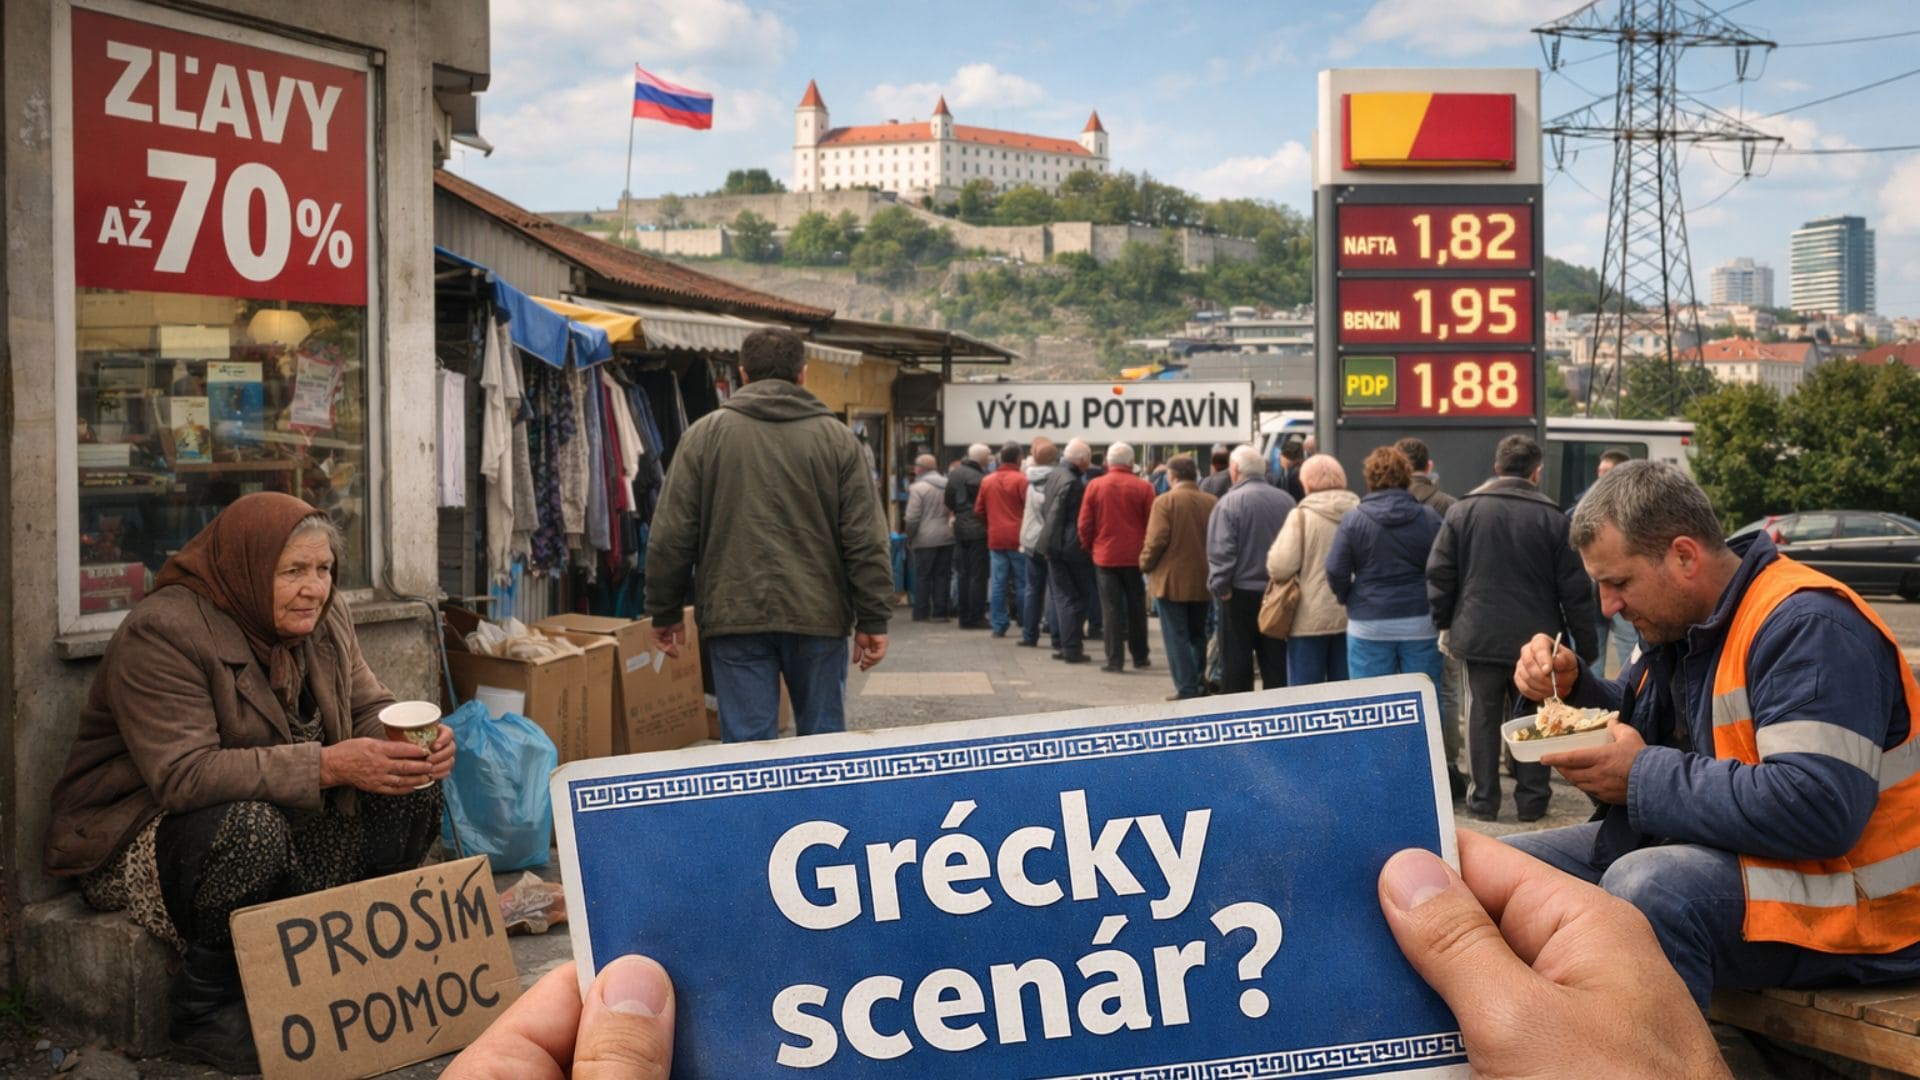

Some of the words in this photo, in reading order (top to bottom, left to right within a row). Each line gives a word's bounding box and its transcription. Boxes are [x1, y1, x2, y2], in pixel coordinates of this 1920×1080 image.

[105, 40, 343, 152] ZĽAVY
[97, 200, 152, 249] AŽ
[147, 148, 354, 282] 70%
[1343, 235, 1398, 256] NAFTA
[1412, 213, 1516, 266] 1,82
[1343, 310, 1401, 331] BENZIN
[1413, 287, 1517, 340] 1,95
[977, 393, 1071, 429] VÝDAJ
[1347, 374, 1389, 396] PDP
[1413, 361, 1519, 415] 1,88
[768, 789, 1212, 930] Grécky
[772, 902, 1283, 1069] scenár?
[281, 1014, 316, 1062] O
